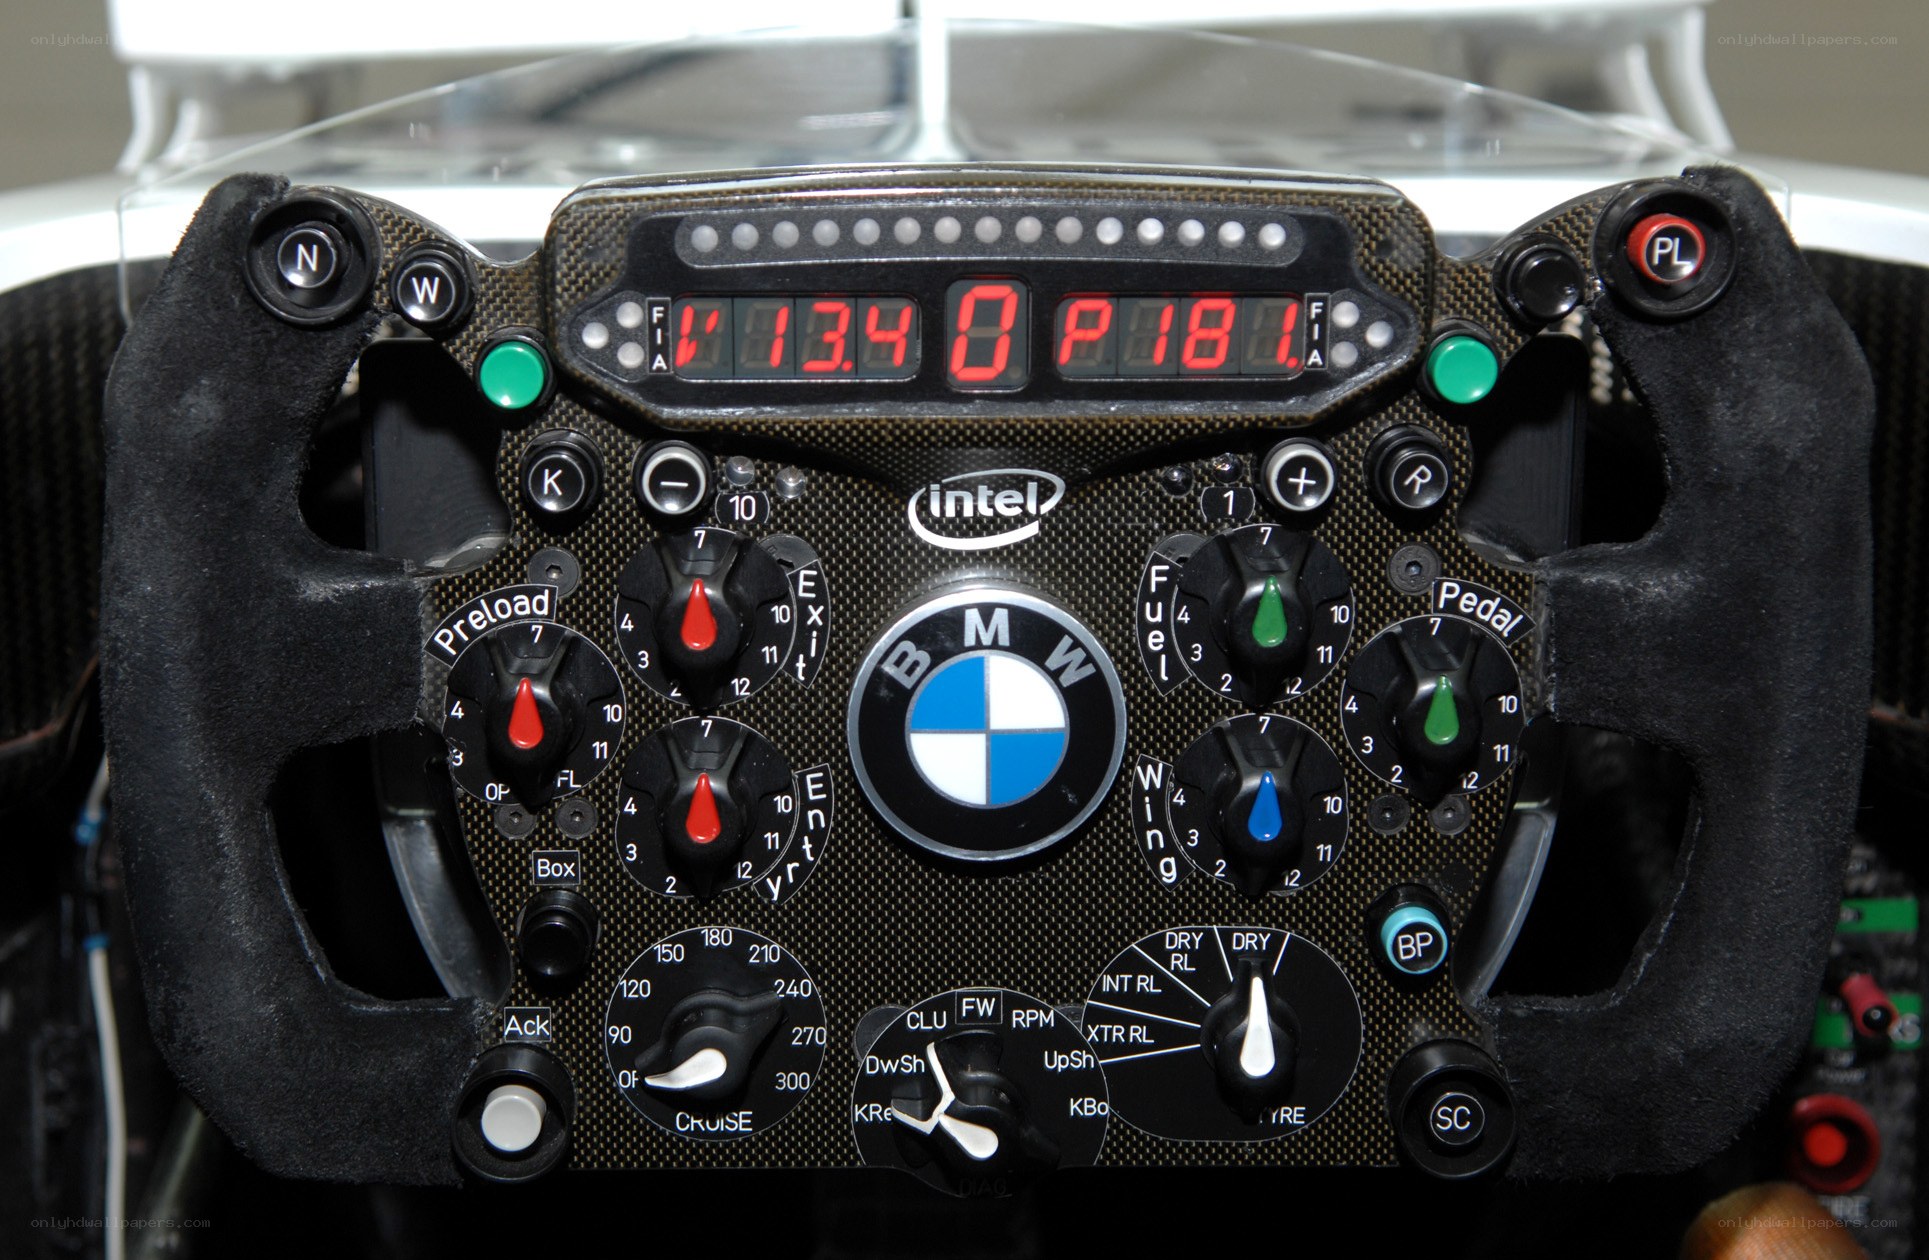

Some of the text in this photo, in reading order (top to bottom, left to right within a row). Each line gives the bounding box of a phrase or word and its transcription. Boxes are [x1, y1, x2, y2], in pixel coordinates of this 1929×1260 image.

[296, 243, 319, 272] N
[1652, 237, 1692, 267] PL
[411, 276, 440, 305] W
[652, 306, 668, 370] FIA
[1306, 302, 1324, 367] FIA
[543, 468, 563, 496] K
[1404, 464, 1433, 495] R
[729, 495, 756, 521] 10
[929, 481, 1039, 518] intel
[1223, 490, 1235, 516] 1
[694, 529, 706, 549] 7
[1260, 526, 1273, 546] 7
[771, 604, 791, 624] 10
[1176, 605, 1191, 624] 4
[1330, 605, 1350, 624] 10
[1438, 581, 1524, 638] Pedal
[433, 588, 550, 656] Preload
[620, 612, 634, 632] 4
[1429, 617, 1442, 636] 7
[531, 624, 543, 644] 7
[761, 645, 778, 664] 11
[880, 607, 1097, 690] BMW
[1190, 643, 1203, 662] 3
[1316, 645, 1332, 664] 11
[638, 650, 649, 669] 3
[730, 677, 751, 696] 12
[1220, 673, 1232, 692] 2
[1285, 676, 1302, 695] 12
[451, 700, 465, 720] 4
[602, 703, 622, 723] 10
[1345, 695, 1359, 714] 4
[1498, 695, 1518, 714] 10
[700, 719, 713, 738] 7
[1259, 716, 1271, 734] 7
[591, 740, 608, 760] 11
[1361, 735, 1374, 754] 3
[1493, 744, 1509, 762] 11
[452, 748, 464, 767] 3
[557, 769, 582, 788] FL
[1391, 765, 1403, 783] 2
[1461, 771, 1479, 790] 12
[623, 796, 638, 815] 4
[773, 795, 793, 814] 10
[1172, 788, 1186, 806] 4
[1323, 796, 1343, 815] 10
[763, 832, 780, 850] 11
[1187, 829, 1200, 847] 3
[626, 843, 637, 862] 3
[1316, 844, 1333, 862] 11
[536, 858, 576, 878] Box
[1215, 859, 1227, 877] 2
[665, 875, 677, 894] 2
[1284, 869, 1301, 887] 12
[701, 928, 733, 947] 180
[1165, 931, 1204, 950] DRY
[1232, 932, 1271, 951] DRY
[1397, 931, 1434, 960] BP
[653, 943, 685, 963] 150
[749, 944, 781, 963] 210
[1171, 954, 1197, 972] RL
[619, 979, 651, 998] 120
[774, 979, 813, 998] 240
[1102, 975, 1162, 993] INT RL
[961, 997, 996, 1017] FW
[504, 1015, 550, 1037] Ack
[906, 1011, 947, 1030] CLU
[1012, 1010, 1055, 1028] RPM
[608, 1025, 632, 1044] 90
[791, 1026, 827, 1046] 270
[1087, 1024, 1155, 1043] XTR RL
[865, 1055, 926, 1075] DwSh
[1044, 1050, 1095, 1072] UpSh
[618, 1070, 640, 1089] OF
[775, 1072, 811, 1091] 300
[1070, 1098, 1109, 1116] KBo
[1259, 1106, 1306, 1125] YRE
[675, 1110, 754, 1132] CRUISE
[1435, 1107, 1472, 1131] SC
